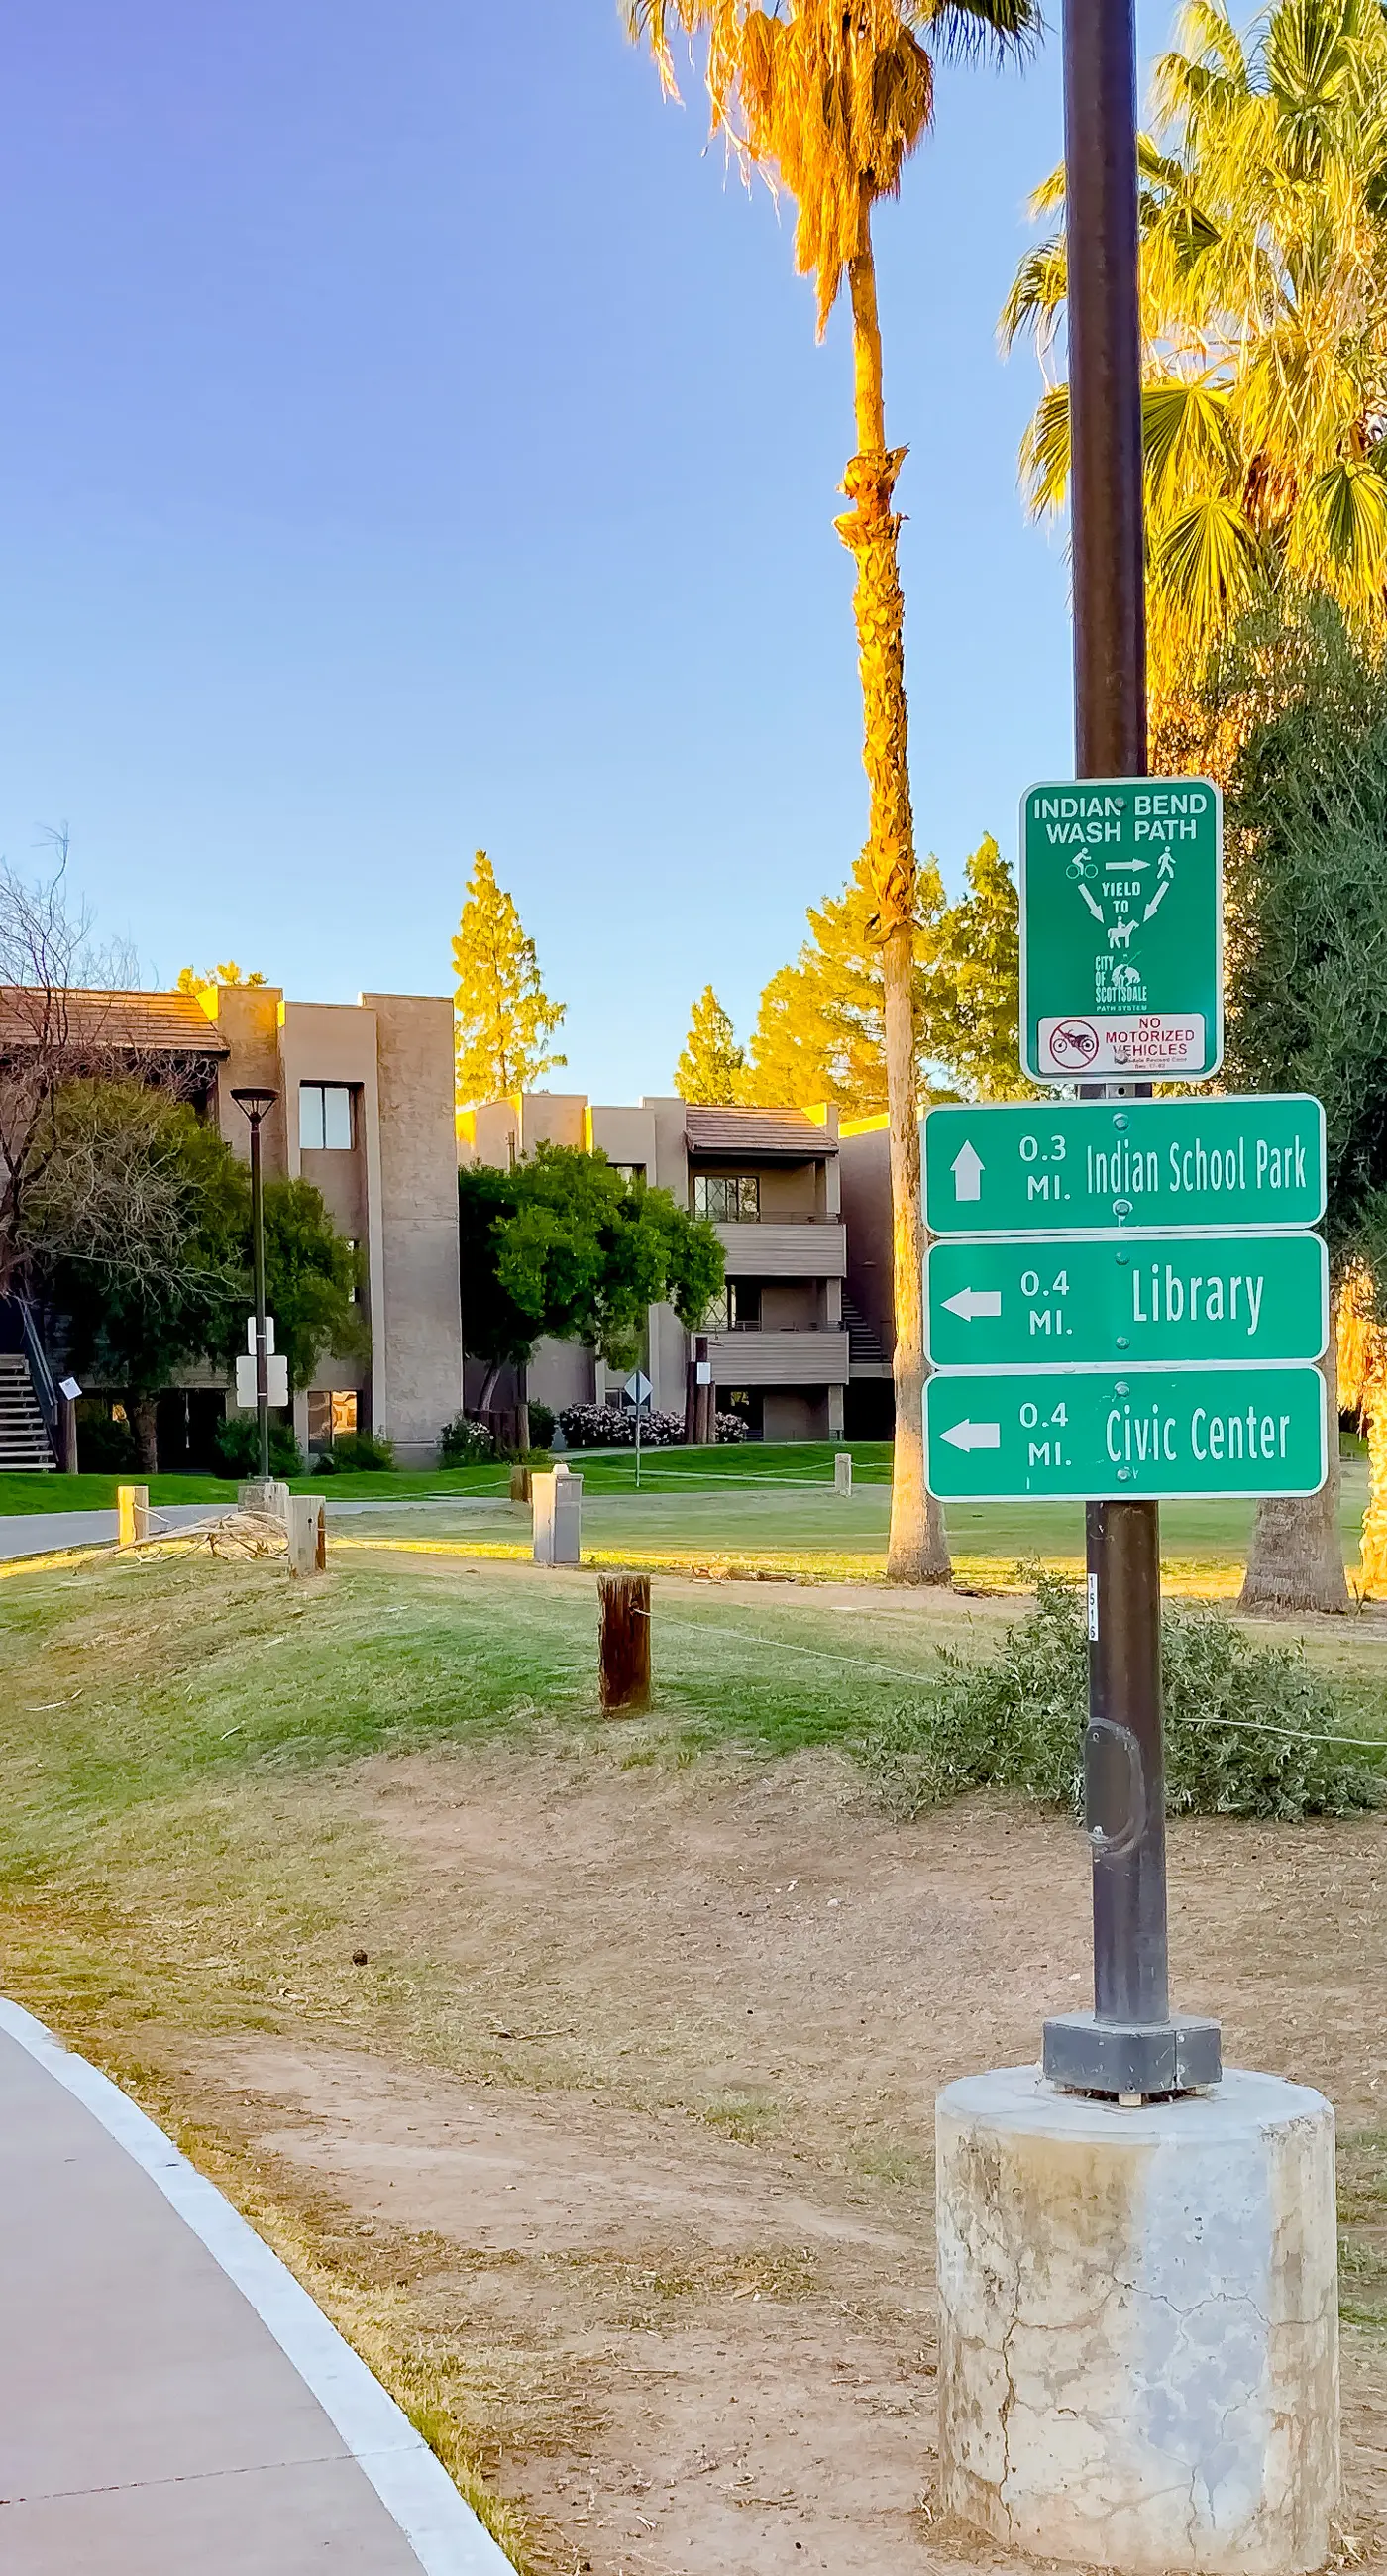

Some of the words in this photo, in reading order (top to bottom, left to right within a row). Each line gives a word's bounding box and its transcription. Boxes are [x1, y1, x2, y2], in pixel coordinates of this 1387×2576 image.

[1034, 797, 1121, 819] INDIAN
[1134, 794, 1208, 816] BEND
[1046, 821, 1121, 844] WASH
[1134, 819, 1197, 842] PATH
[1102, 882, 1141, 897] YIELD
[1113, 900, 1129, 913] TO
[1095, 955, 1115, 971] CITY
[1095, 971, 1106, 986] OF
[1095, 986, 1147, 1003] SCOTTSDALE
[1138, 1018, 1161, 1029] NO
[1105, 1030, 1195, 1044] MOTORIZED
[1113, 1043, 1188, 1058] VEHICLES
[1018, 1135, 1067, 1162] 0.3
[1087, 1139, 1158, 1193] Indian
[1169, 1136, 1246, 1192] School
[1256, 1135, 1307, 1189] Park
[1027, 1175, 1070, 1200] MI.
[1020, 1271, 1070, 1297] 0.4
[1132, 1263, 1264, 1336] Library
[1029, 1310, 1073, 1335] MI.
[1019, 1402, 1069, 1428] 0.4
[1106, 1404, 1177, 1461] Civic
[1191, 1406, 1291, 1460] Center
[1028, 1442, 1072, 1466] MI.
